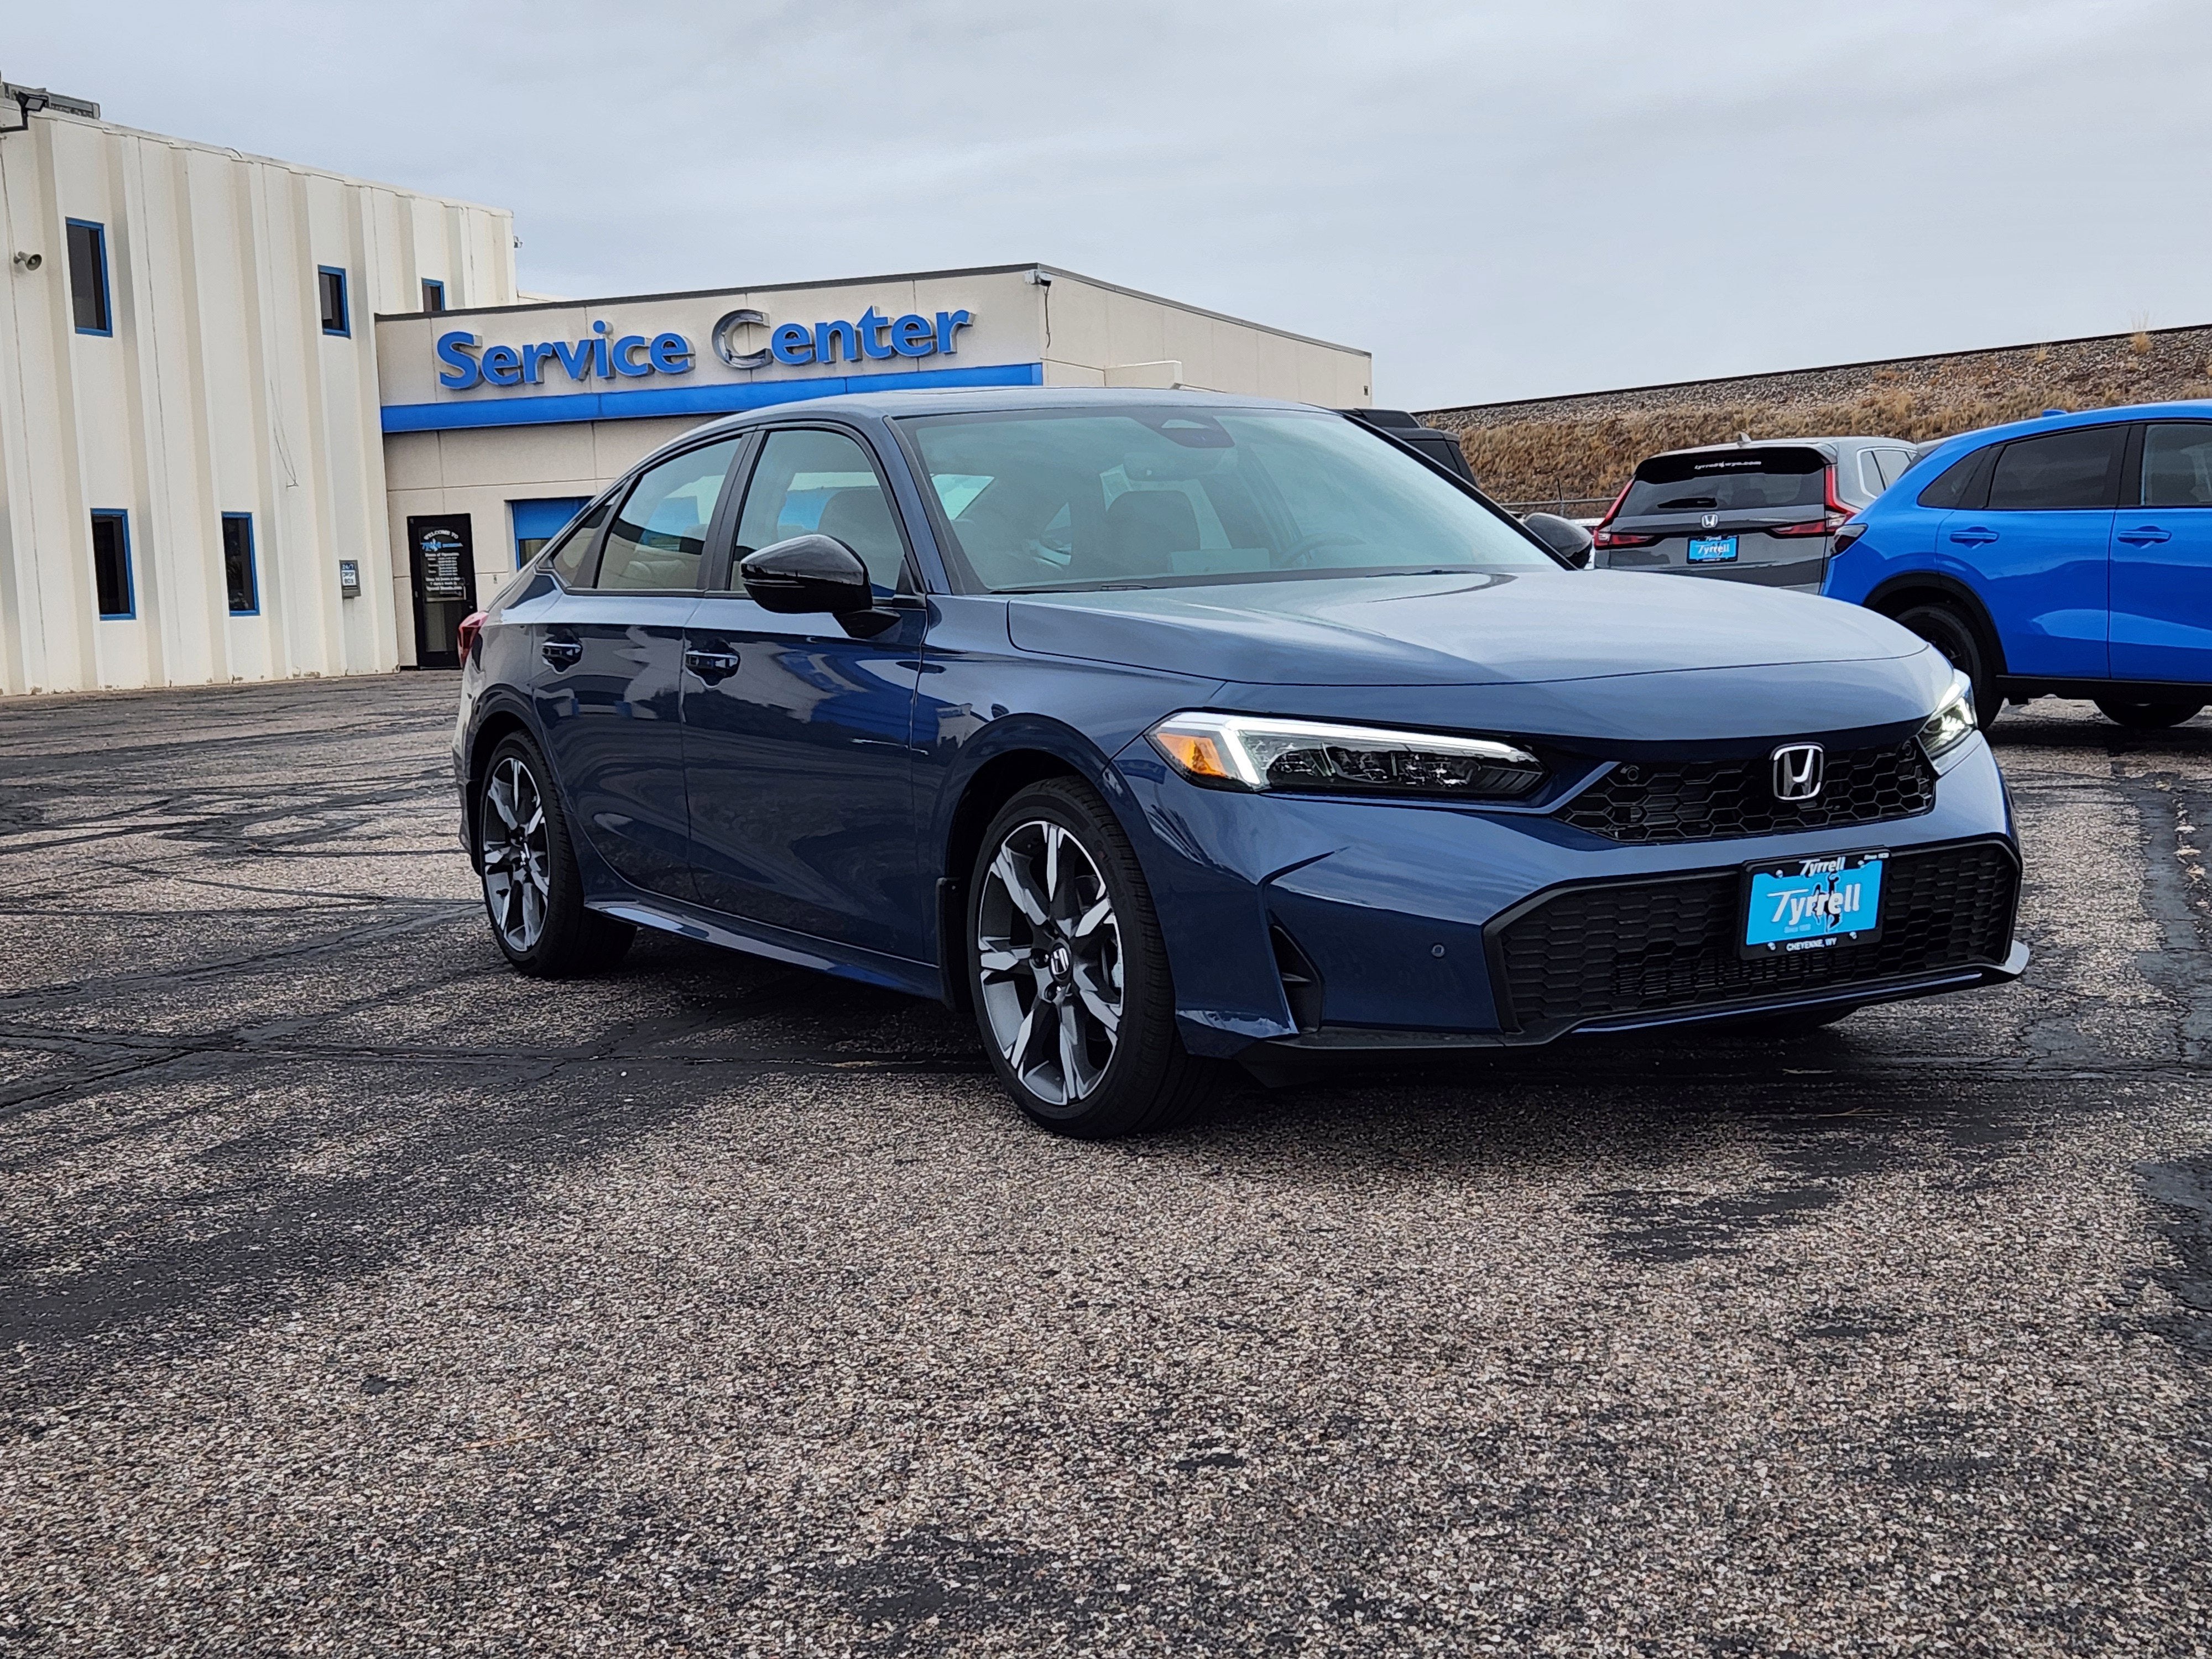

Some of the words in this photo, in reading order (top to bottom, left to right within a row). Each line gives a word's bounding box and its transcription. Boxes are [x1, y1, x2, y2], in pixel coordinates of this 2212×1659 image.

[437, 320, 696, 389] Service
[711, 305, 976, 370] Center
[1696, 542, 1730, 555] Tyrrell
[1798, 856, 1846, 877] Tyrrell
[1767, 883, 1861, 925] Tyrrell
